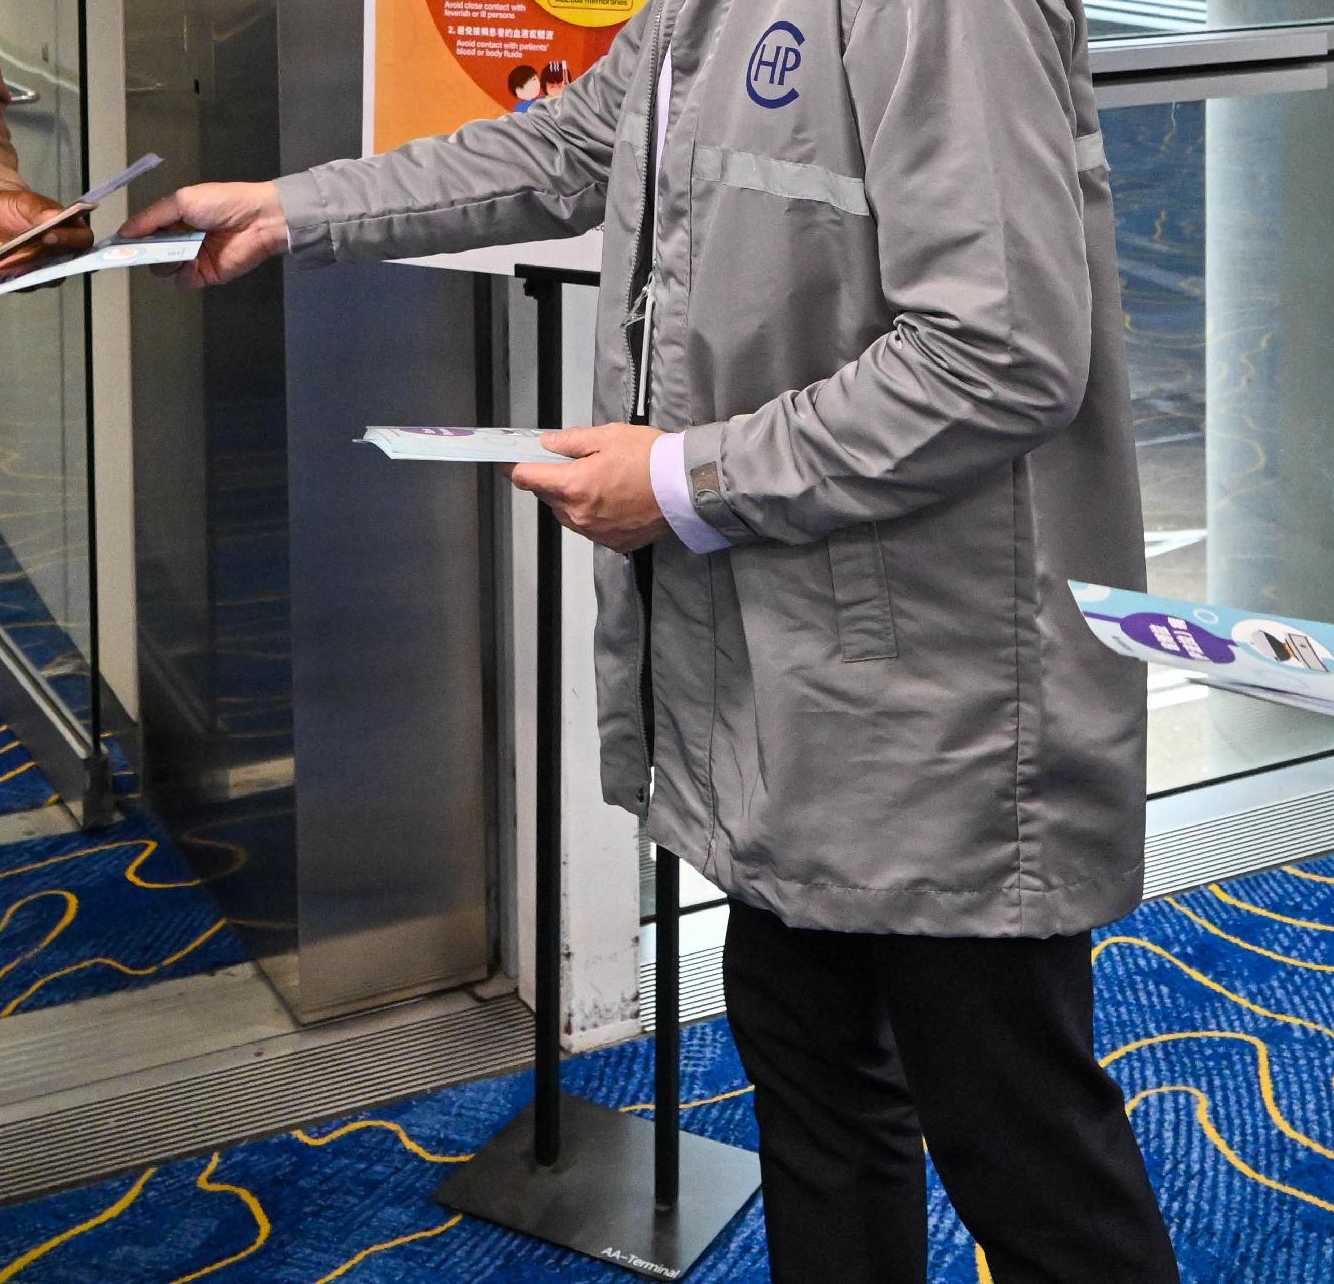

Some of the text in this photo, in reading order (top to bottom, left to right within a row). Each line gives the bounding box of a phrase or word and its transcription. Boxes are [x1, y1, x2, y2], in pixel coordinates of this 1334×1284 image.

[444, 1, 526, 11] Avoid close contact with
[444, 9, 471, 17] feverish
[487, 12, 515, 20] persons
[456, 40, 475, 48] Avoid
[476, 41, 502, 49] contact
[504, 42, 518, 50] with
[456, 48, 475, 56] blood
[485, 49, 502, 57] body
[503, 50, 523, 58] fluids
[601, 1247, 681, 1279] AA-Terminal
